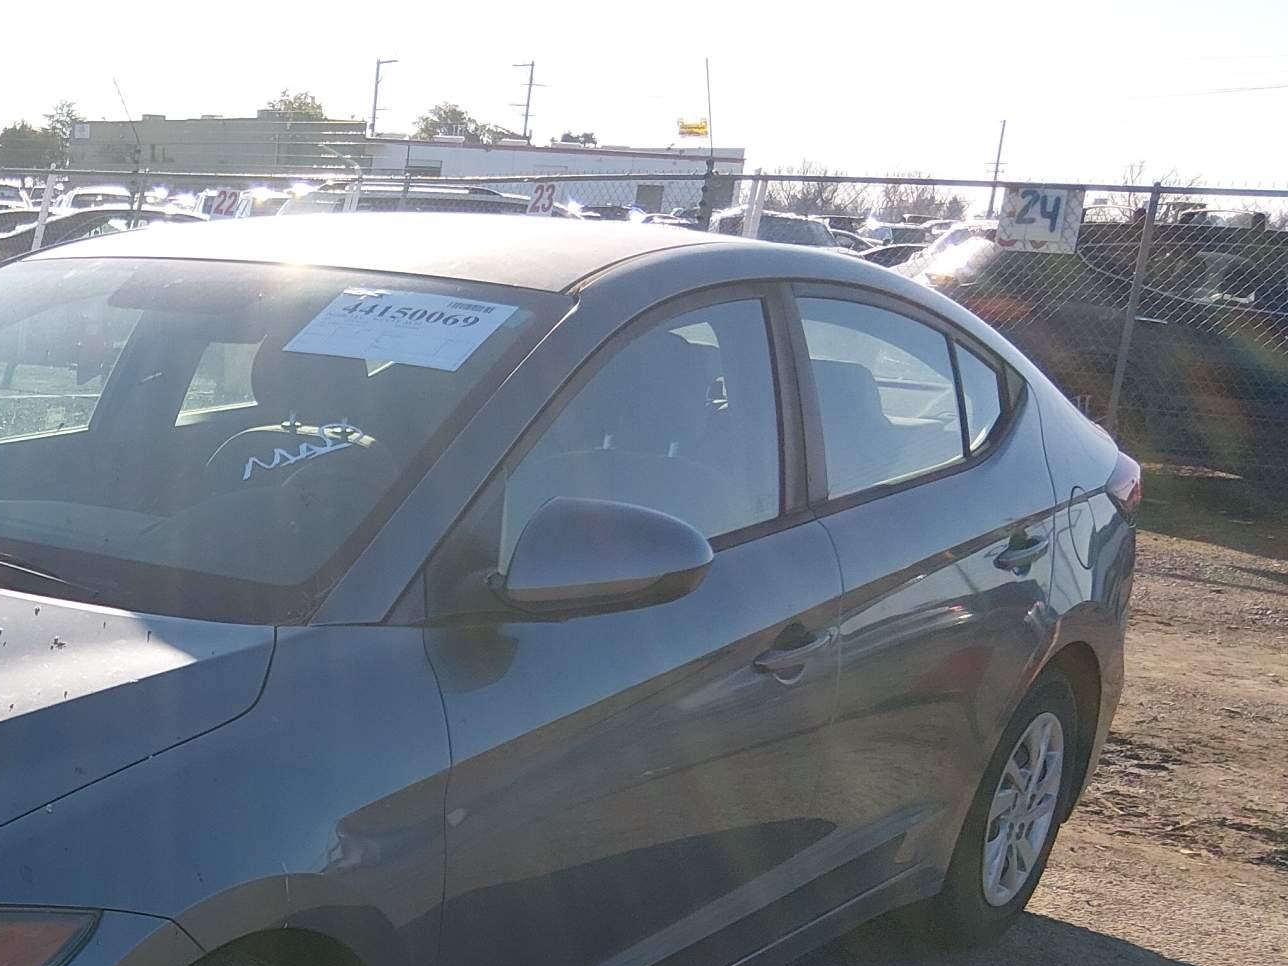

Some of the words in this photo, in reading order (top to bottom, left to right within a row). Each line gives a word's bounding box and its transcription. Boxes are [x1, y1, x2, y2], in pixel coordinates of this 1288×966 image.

[213, 190, 237, 216] 22
[528, 184, 555, 213] 23
[1015, 189, 1061, 233] 24
[342, 302, 480, 328] 44150069
